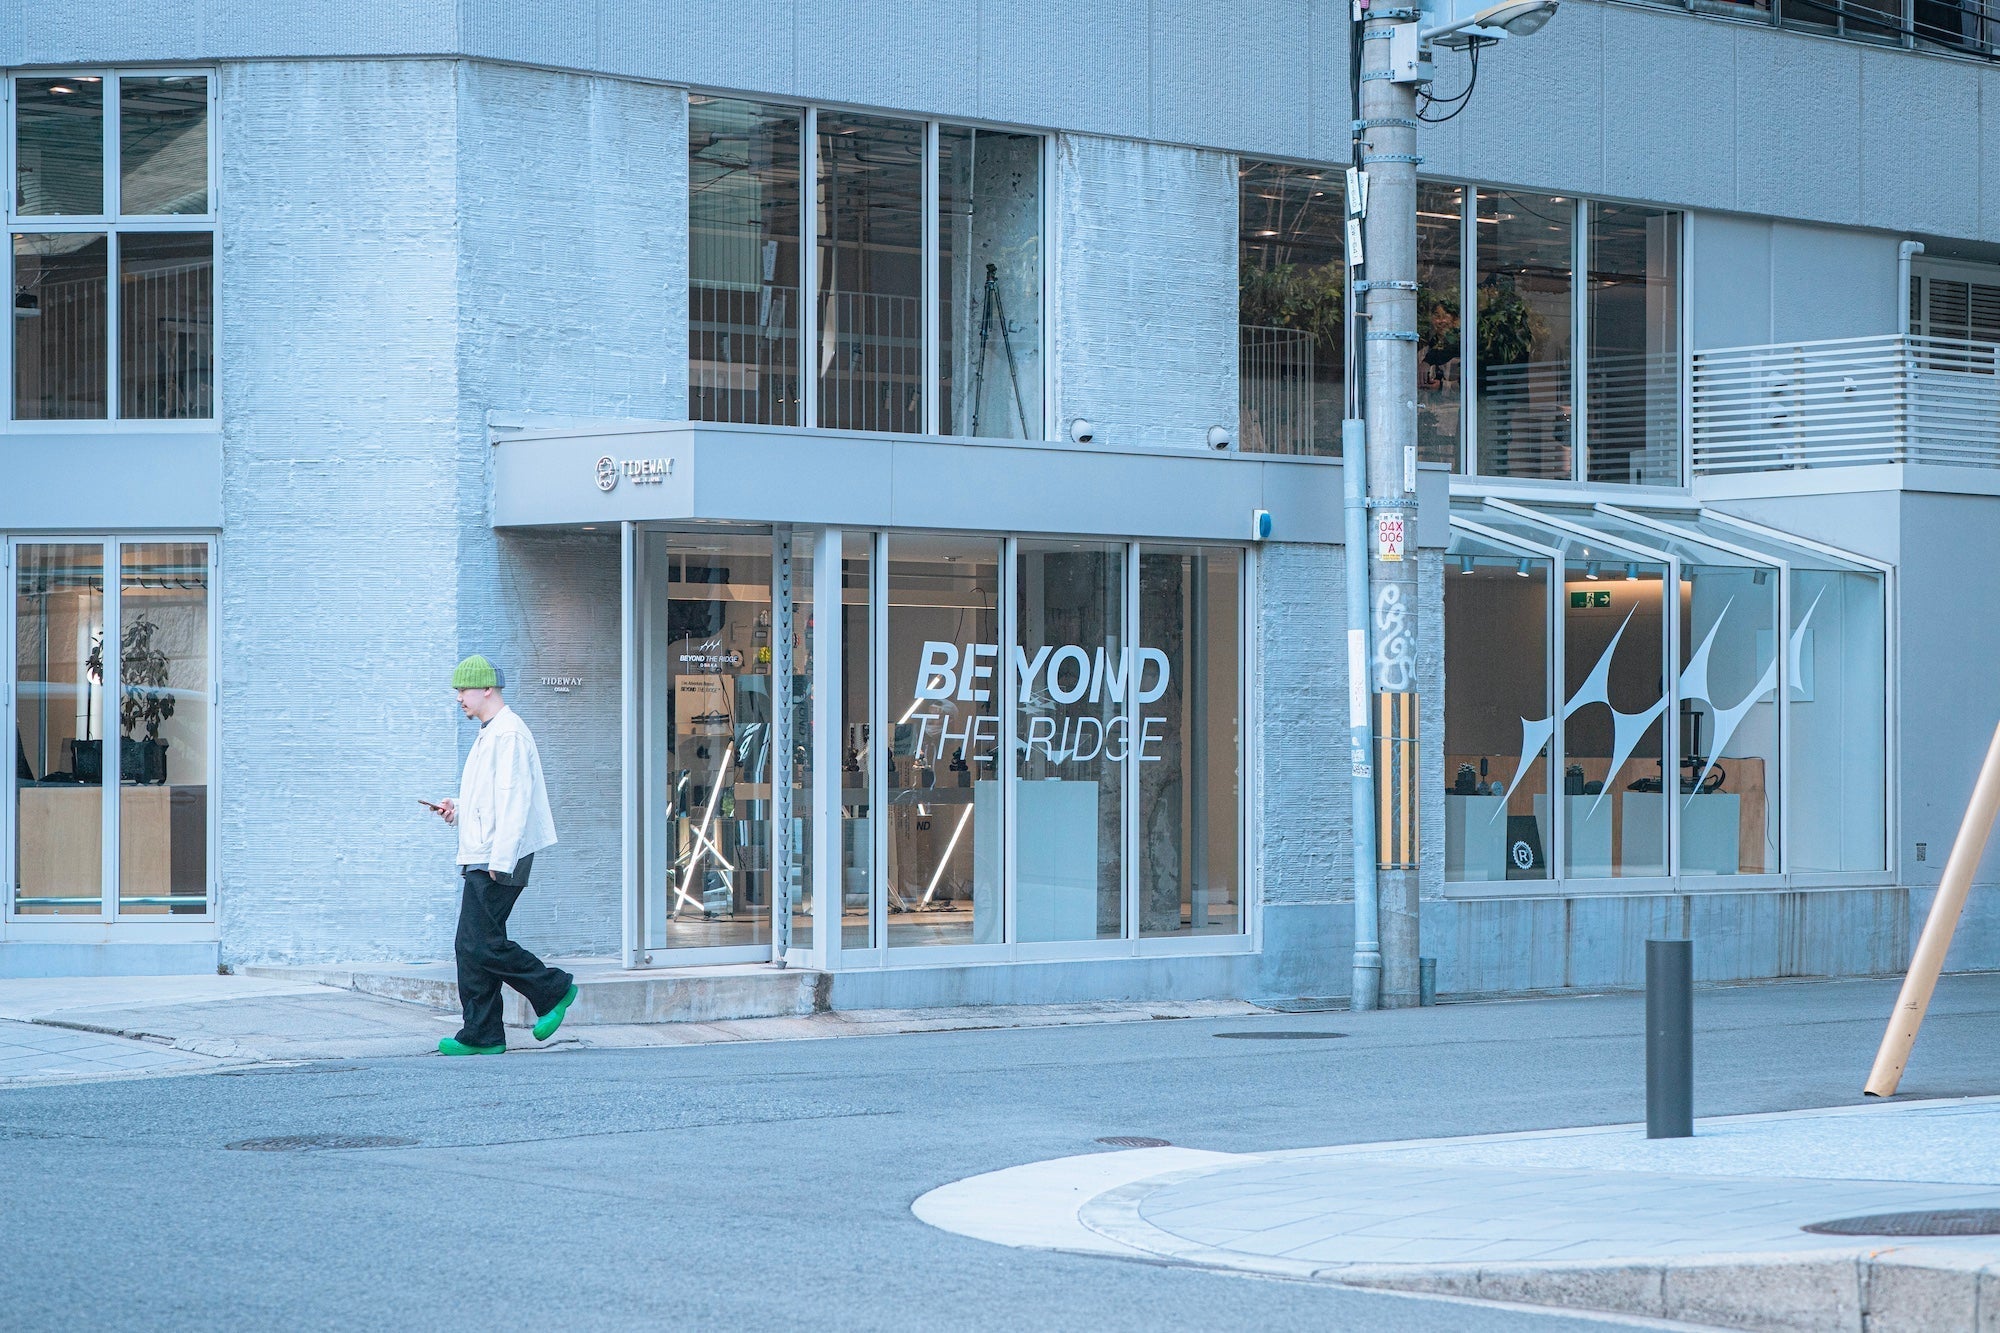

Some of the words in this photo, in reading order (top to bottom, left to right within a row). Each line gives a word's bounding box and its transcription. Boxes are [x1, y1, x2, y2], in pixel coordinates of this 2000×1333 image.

[620, 458, 673, 475] TIDEWAY
[1380, 521, 1403, 532] 04X
[1380, 532, 1403, 543] 006
[1388, 543, 1396, 553] A
[706, 655, 718, 663] THE
[914, 641, 1170, 704] BEYOND
[541, 677, 583, 686] TIDEWAY
[911, 713, 999, 761] THE
[1025, 716, 1167, 762] RIDGE
[1518, 849, 1528, 861] R
